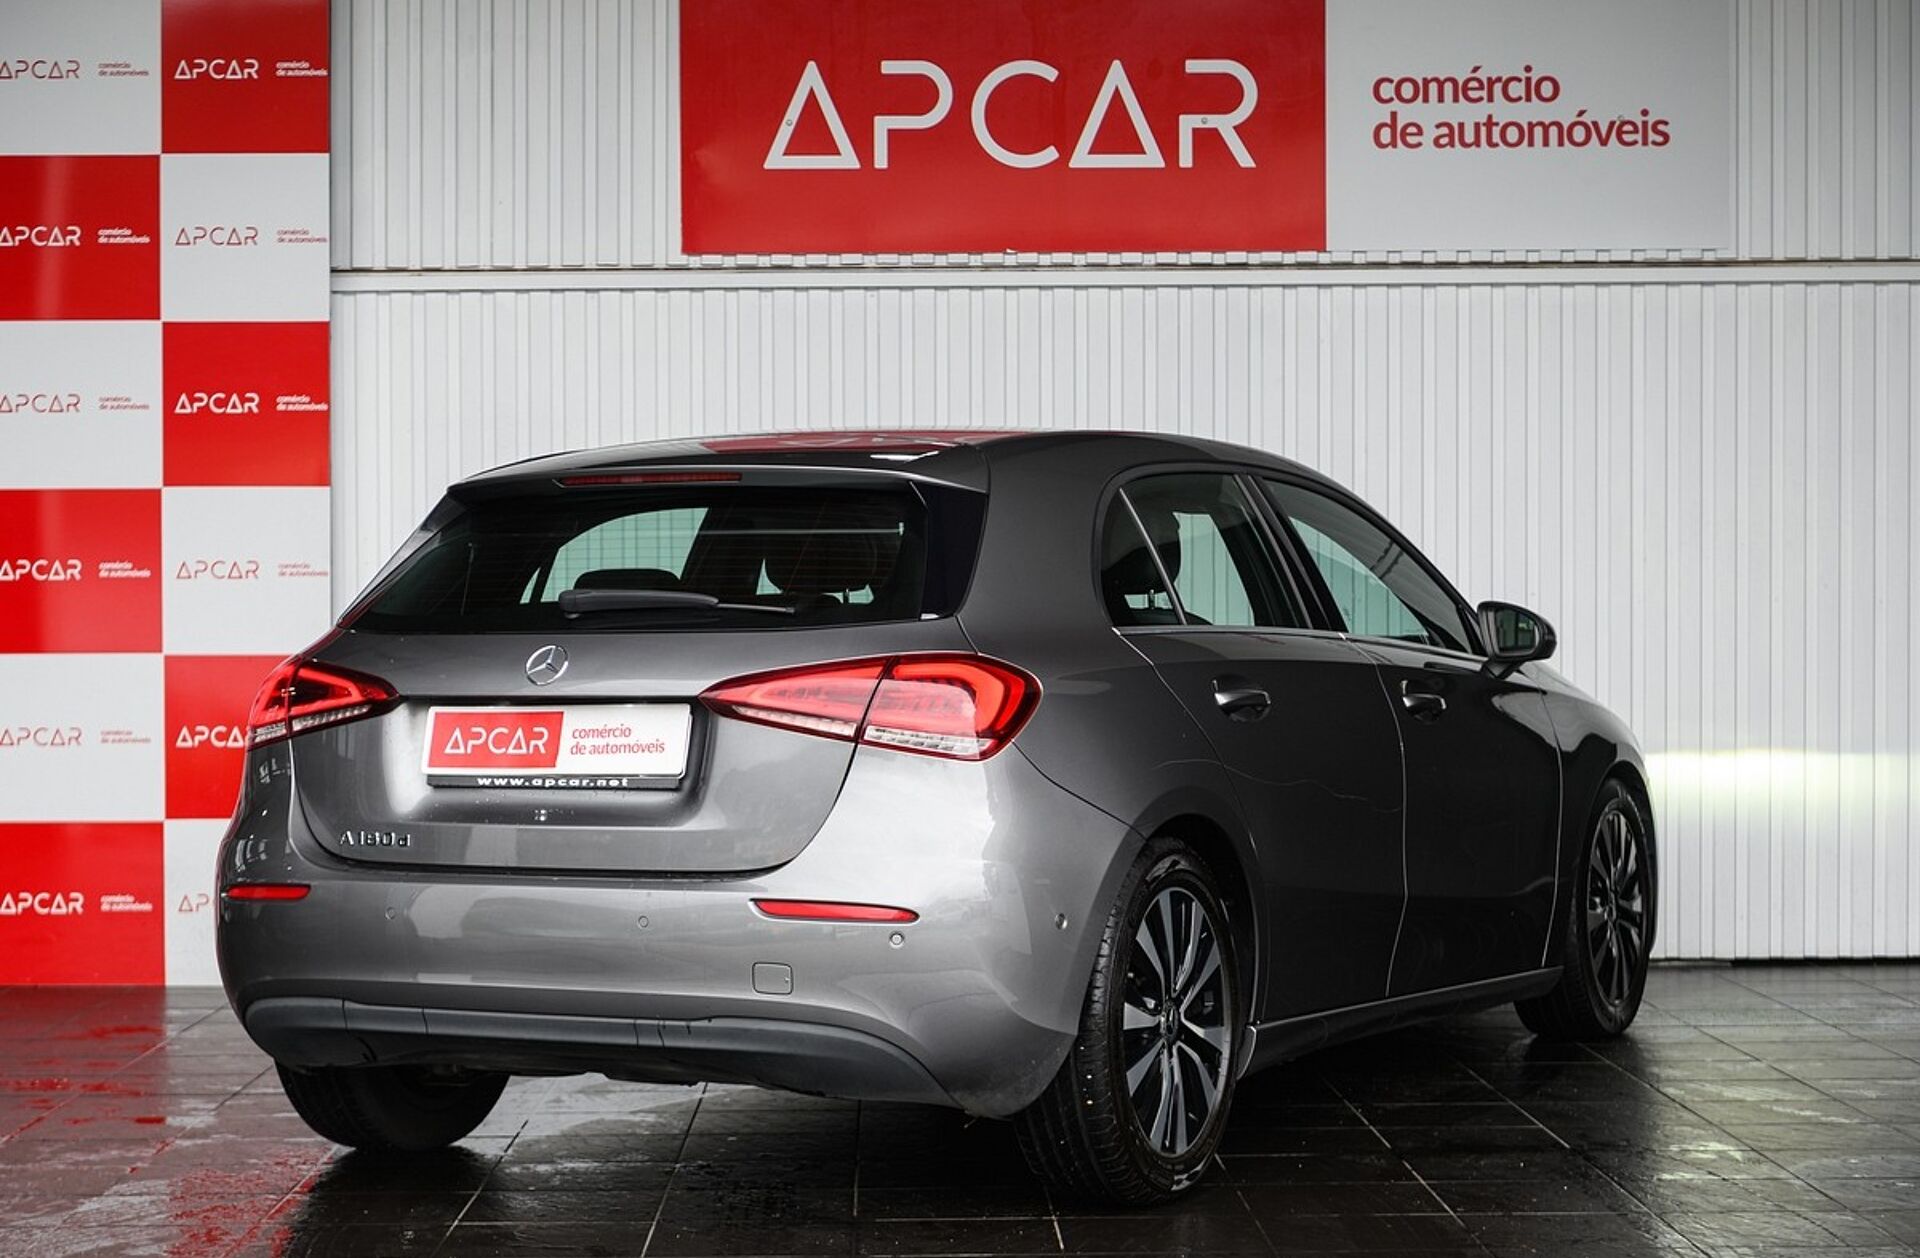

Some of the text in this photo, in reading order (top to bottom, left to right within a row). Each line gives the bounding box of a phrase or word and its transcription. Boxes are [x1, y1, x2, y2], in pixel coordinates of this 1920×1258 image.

[0, 60, 80, 79] APCAR
[174, 59, 259, 80] APCAR
[1372, 65, 1561, 104] comércio
[763, 60, 1259, 170] APCAR
[1372, 108, 1671, 149] de automóveis
[0, 226, 81, 247] APCAR
[175, 227, 259, 246] APCAR
[0, 394, 81, 413] APCAR
[174, 392, 260, 414] APCAR
[0, 559, 82, 581] APCAR
[176, 560, 260, 580] APCAR
[0, 727, 82, 746] APCAR
[175, 725, 249, 749] APCA
[443, 726, 549, 755] APCAR
[571, 723, 632, 739] comércio
[570, 739, 666, 756] de automóveis
[477, 777, 629, 788] www.apcar.net
[0, 891, 84, 915] APCAR
